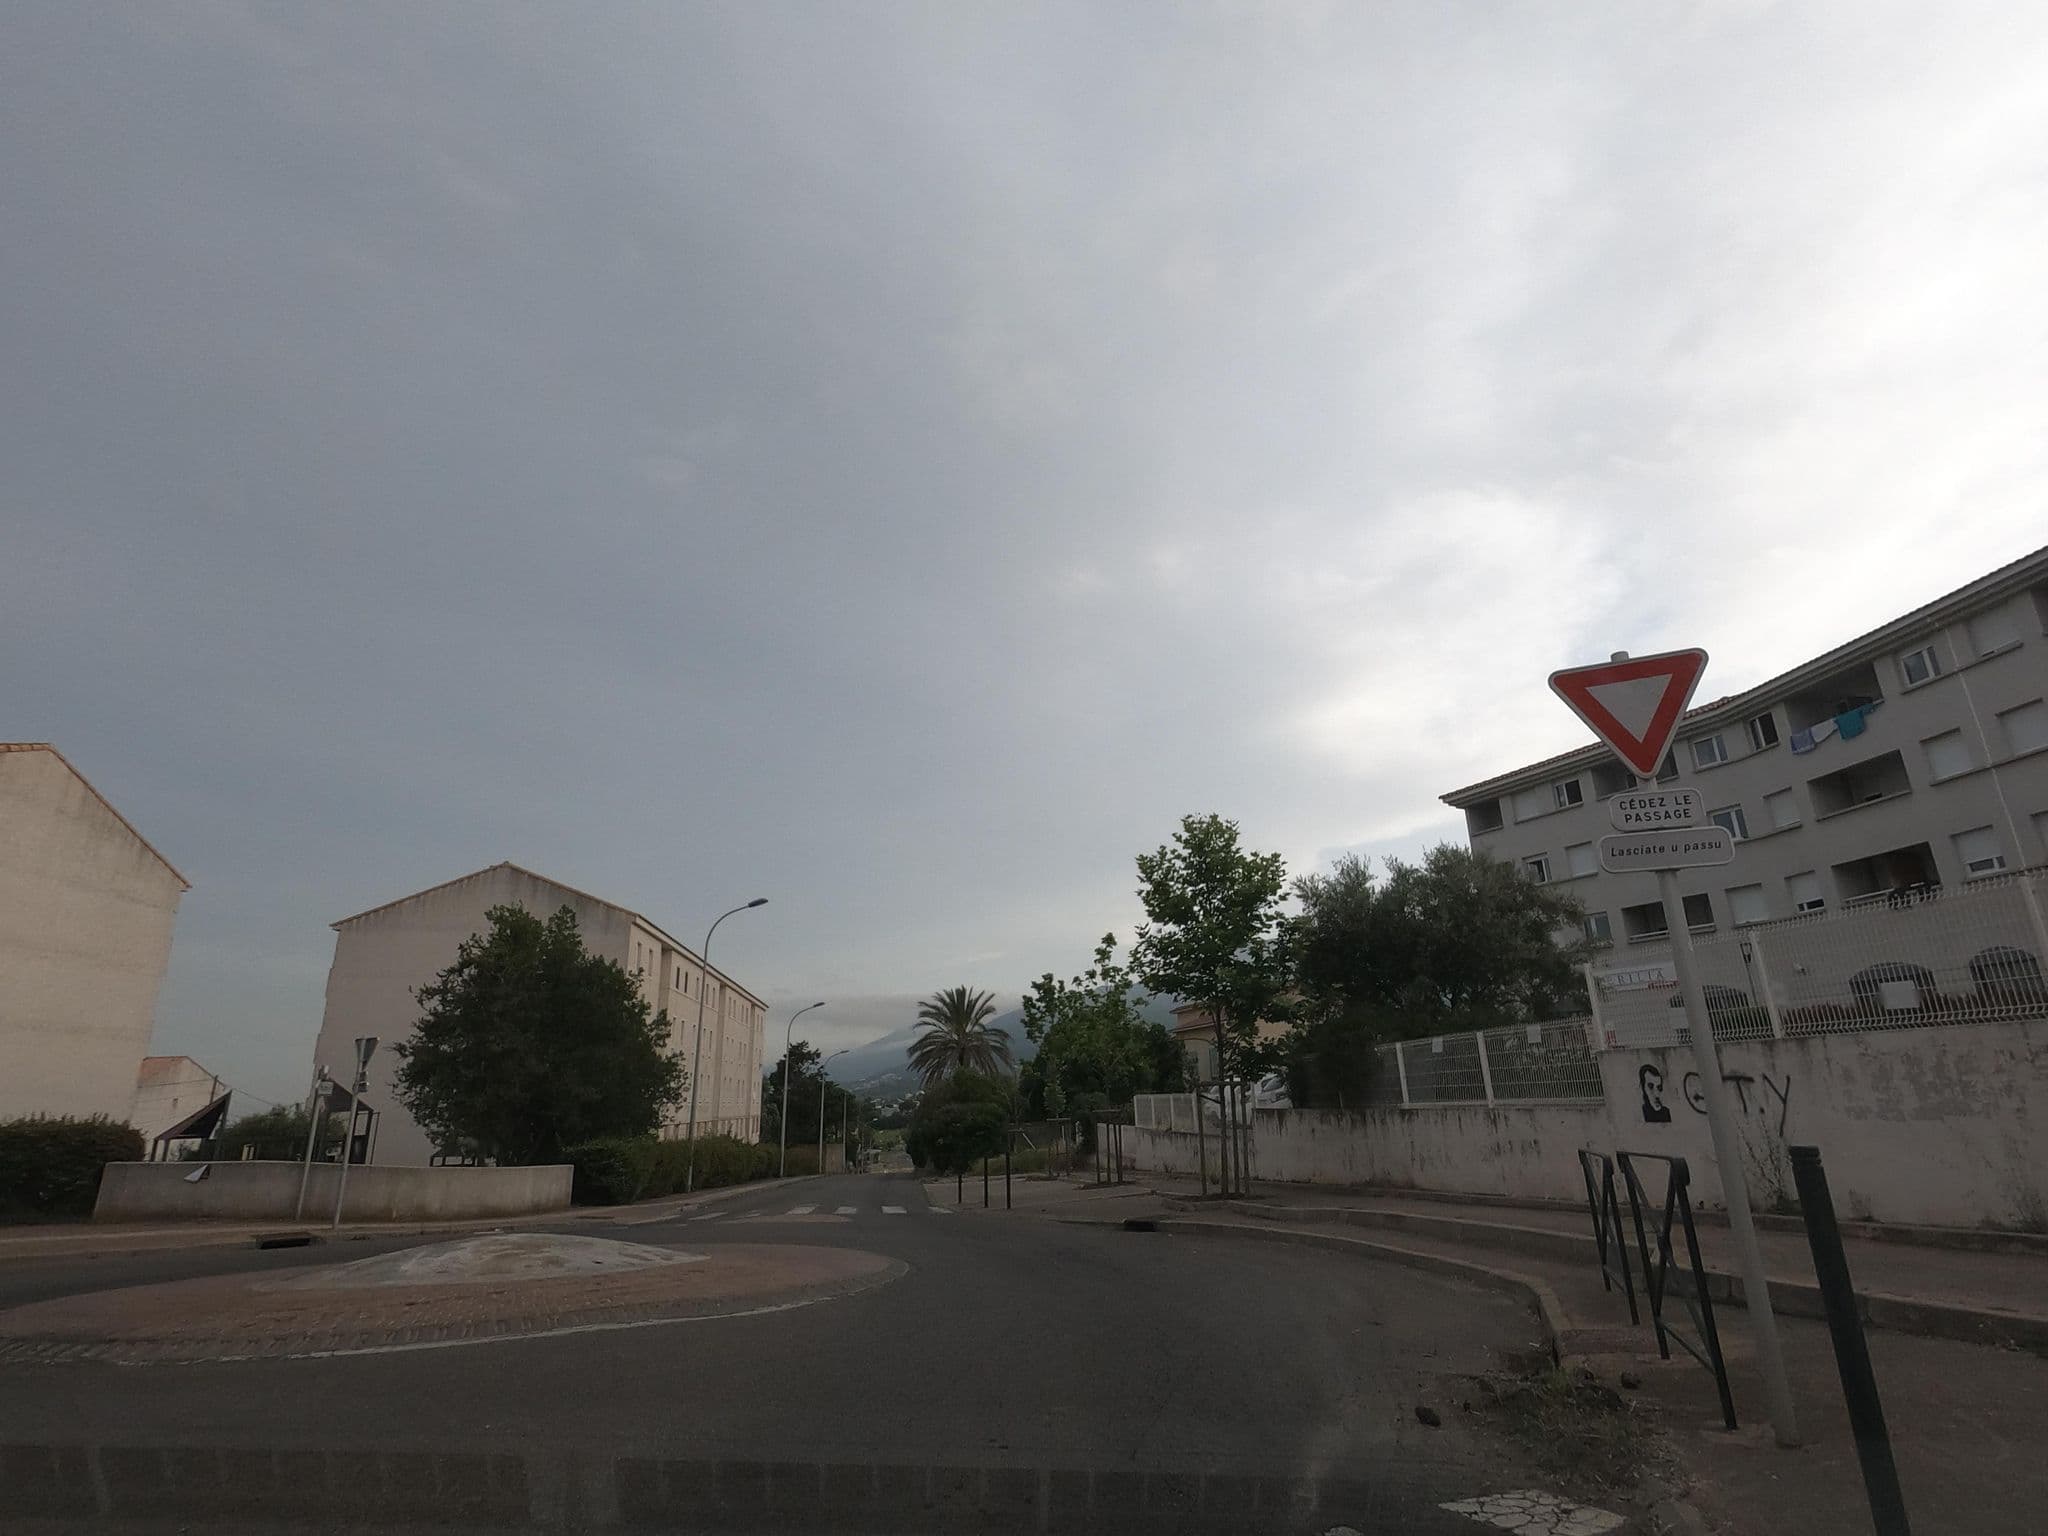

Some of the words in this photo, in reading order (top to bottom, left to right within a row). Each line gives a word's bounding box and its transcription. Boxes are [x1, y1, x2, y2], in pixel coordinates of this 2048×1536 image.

[1619, 797, 1666, 810] CÉDEZ
[1674, 795, 1692, 806] LE
[1624, 809, 1692, 823] PASSAGE
[1611, 843, 1665, 857] Lasciate
[1671, 845, 1678, 853] u
[1684, 840, 1721, 854] passu
